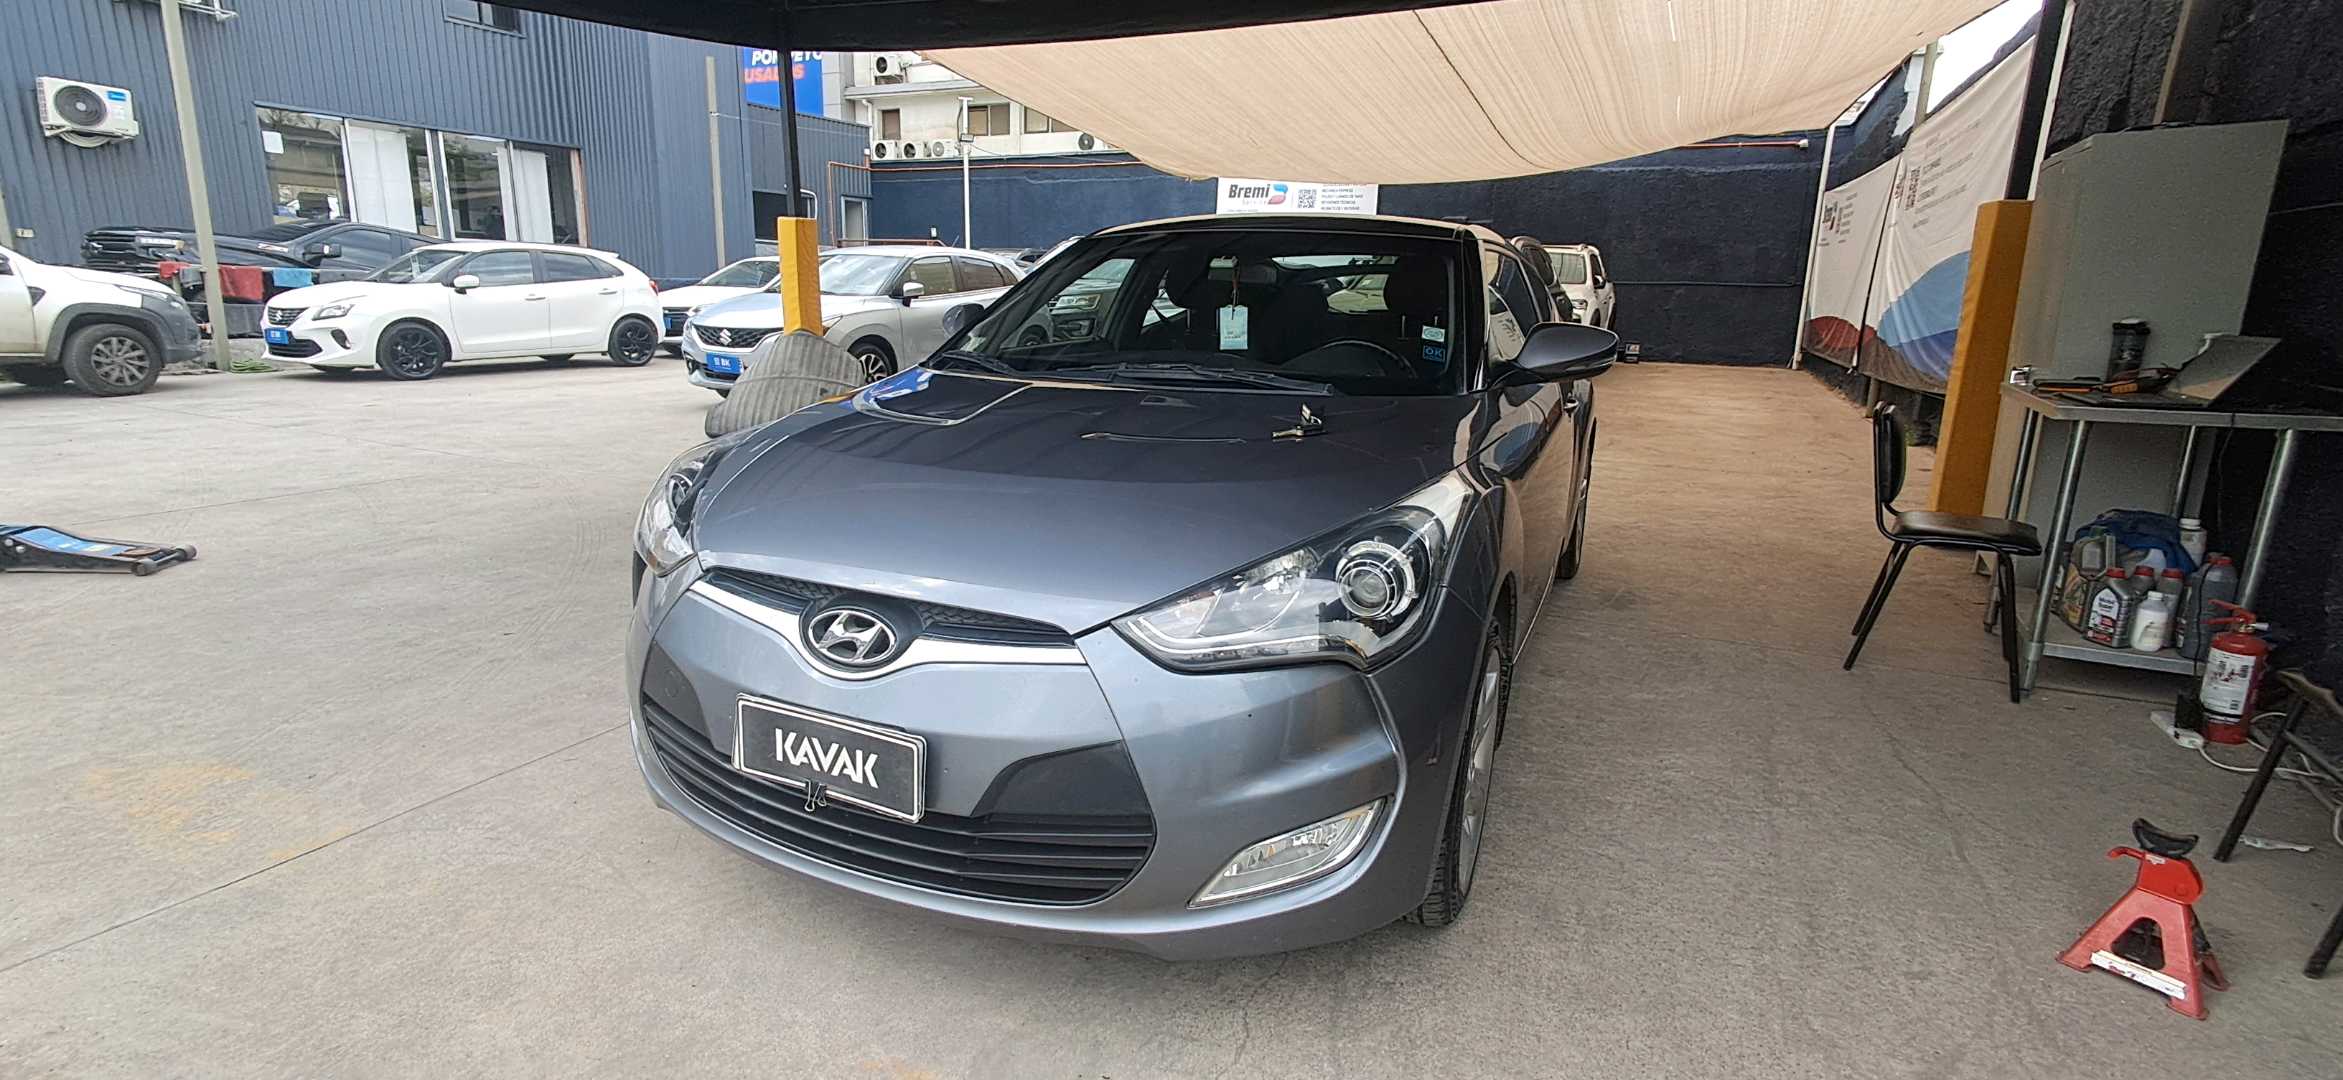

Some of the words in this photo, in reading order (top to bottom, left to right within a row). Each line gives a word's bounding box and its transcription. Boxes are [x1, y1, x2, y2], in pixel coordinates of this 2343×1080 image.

[752, 50, 822, 66] POEYO
[745, 64, 804, 84] USAS
[1228, 183, 1271, 198] Bremi
[775, 728, 878, 788] KAVAK
